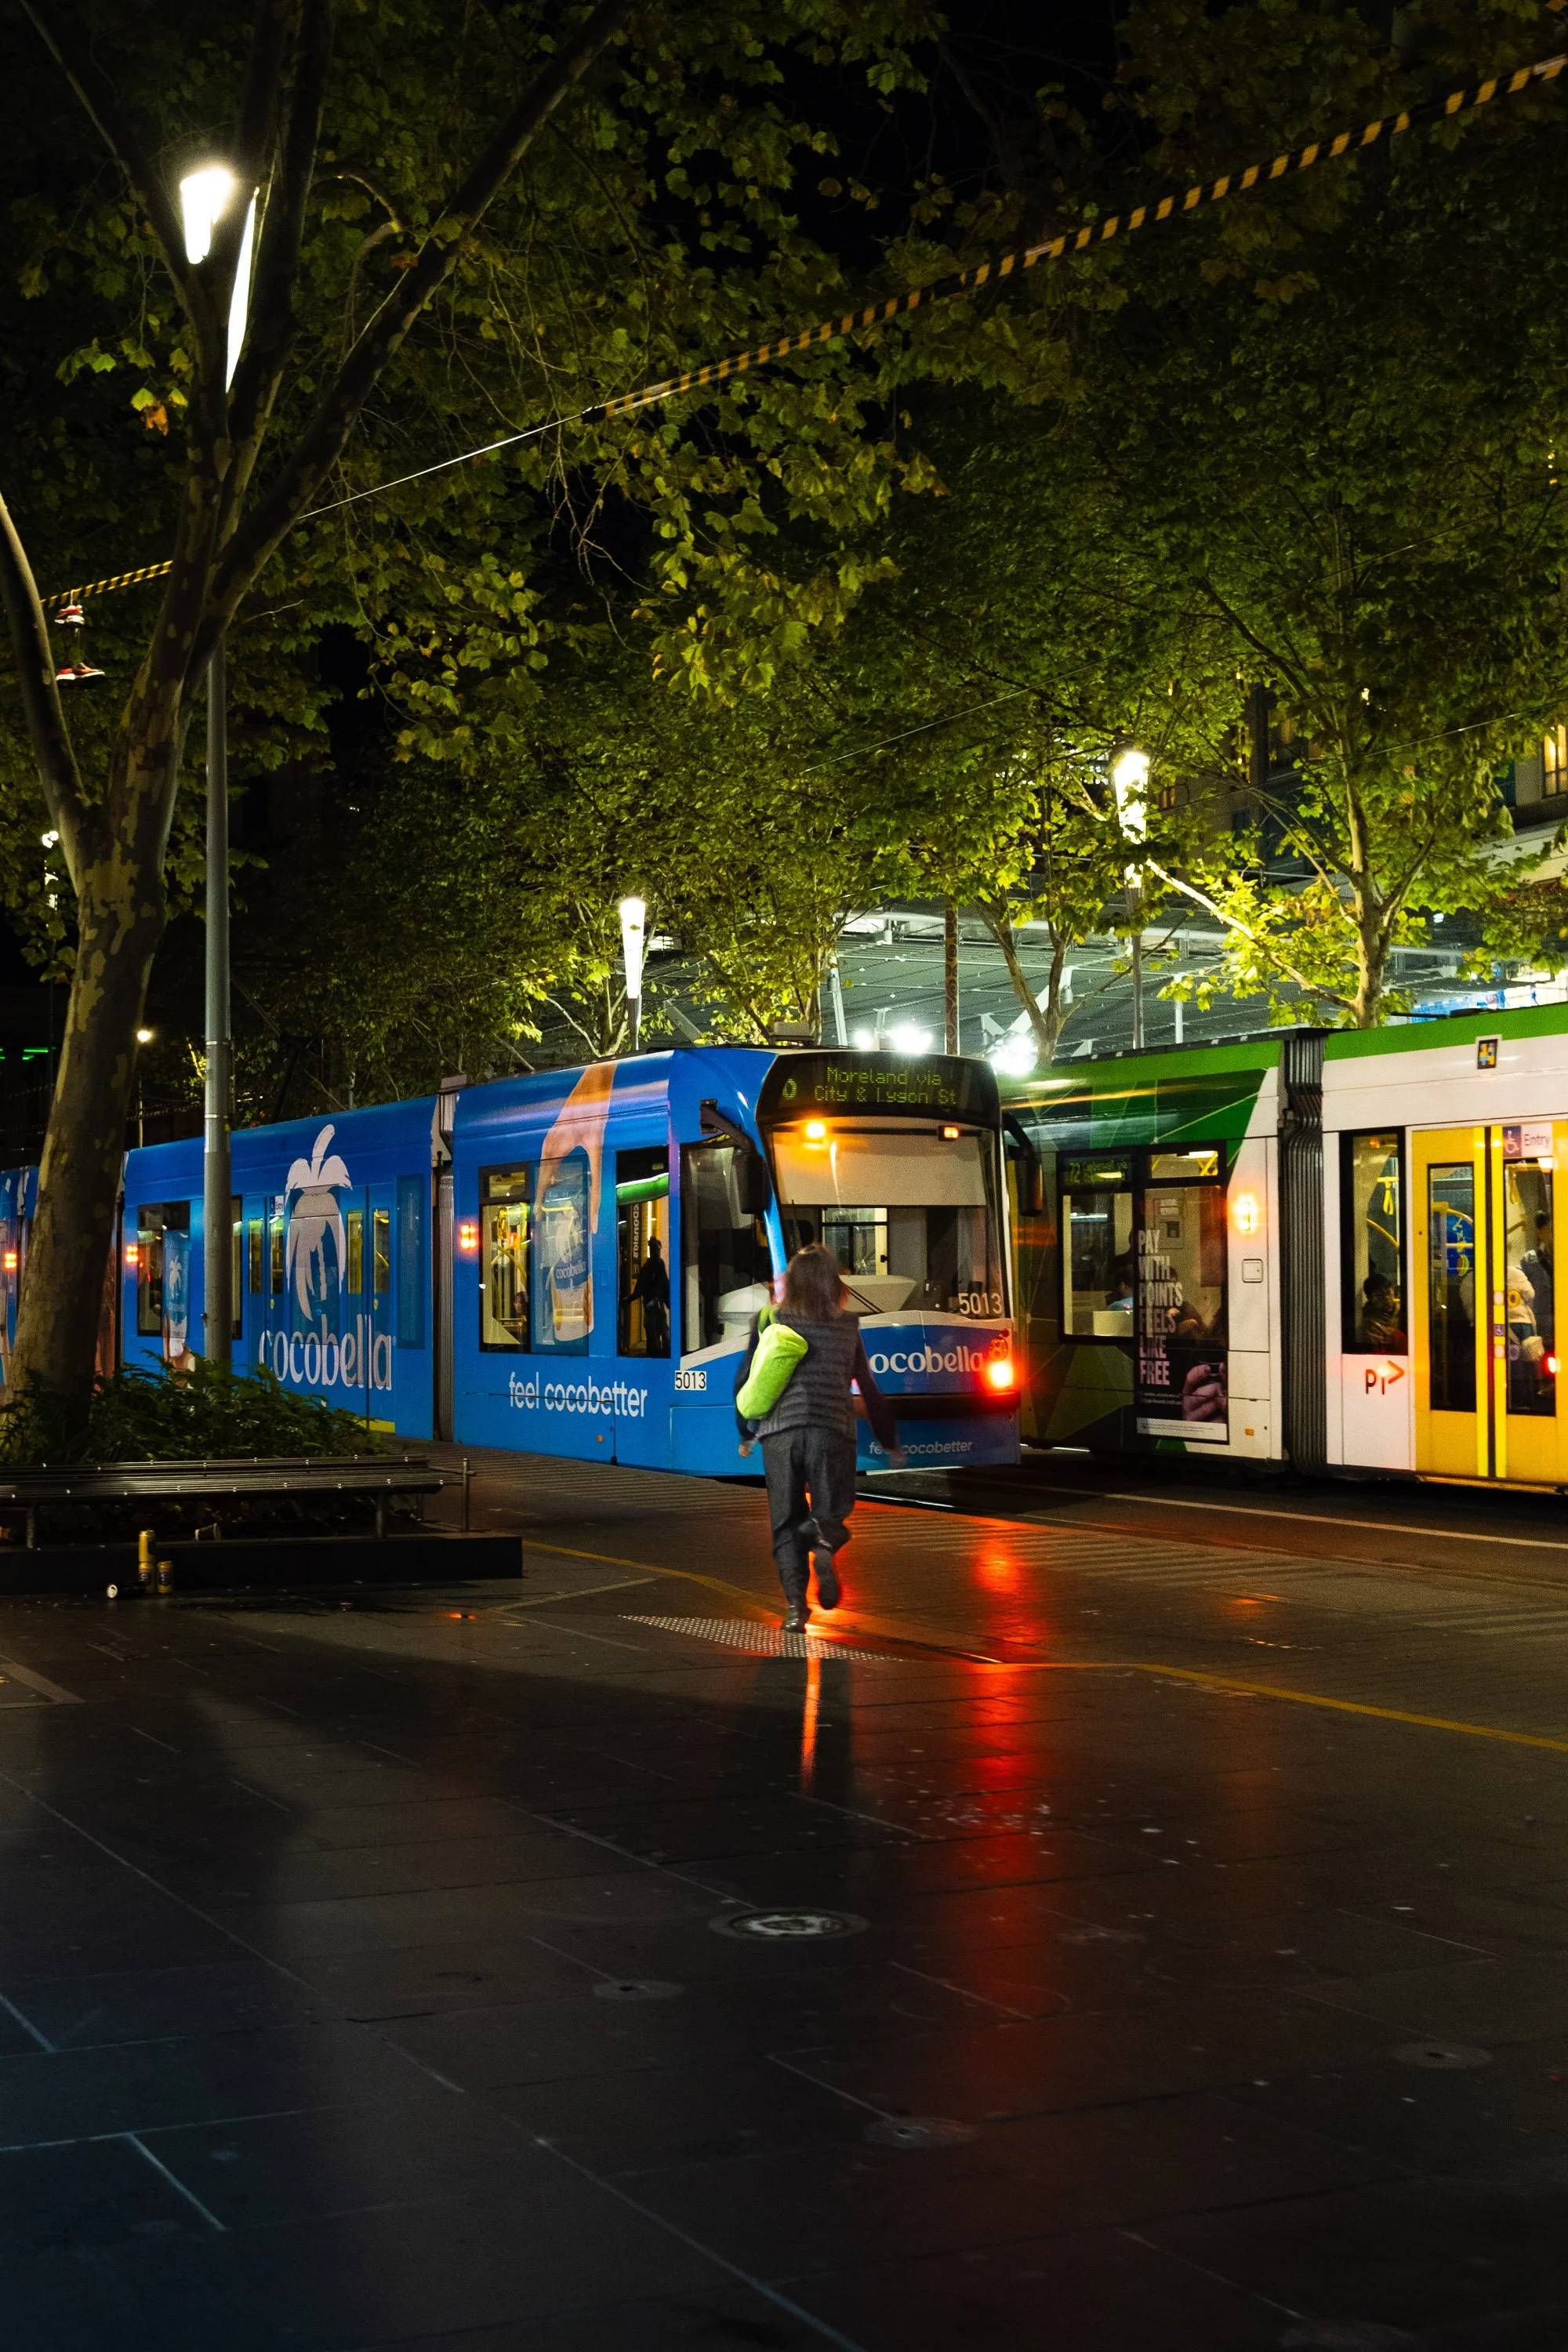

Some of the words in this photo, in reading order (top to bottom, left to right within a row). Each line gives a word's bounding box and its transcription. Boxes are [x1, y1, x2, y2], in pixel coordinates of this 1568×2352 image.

[827, 1067, 908, 1085] Moreland
[916, 1070, 942, 1086] via
[814, 1085, 848, 1102] City
[856, 1087, 867, 1102] &
[877, 1087, 929, 1104] Lygon
[938, 1088, 956, 1105] St
[1524, 1134, 1550, 1149] Entry
[1138, 1229, 1160, 1254] PAY
[1138, 1255, 1171, 1279] WITH
[958, 1292, 1003, 1315] 5013
[1138, 1282, 1183, 1307] POINTS
[1139, 1308, 1177, 1334] FELS
[259, 1313, 392, 1391] cocobella
[1139, 1334, 1168, 1359] LIKE
[869, 1345, 985, 1374] ocobella
[675, 1372, 706, 1390] 5013
[1139, 1360, 1171, 1386] FREE
[509, 1371, 539, 1409] feel
[544, 1375, 648, 1418] cocobetter
